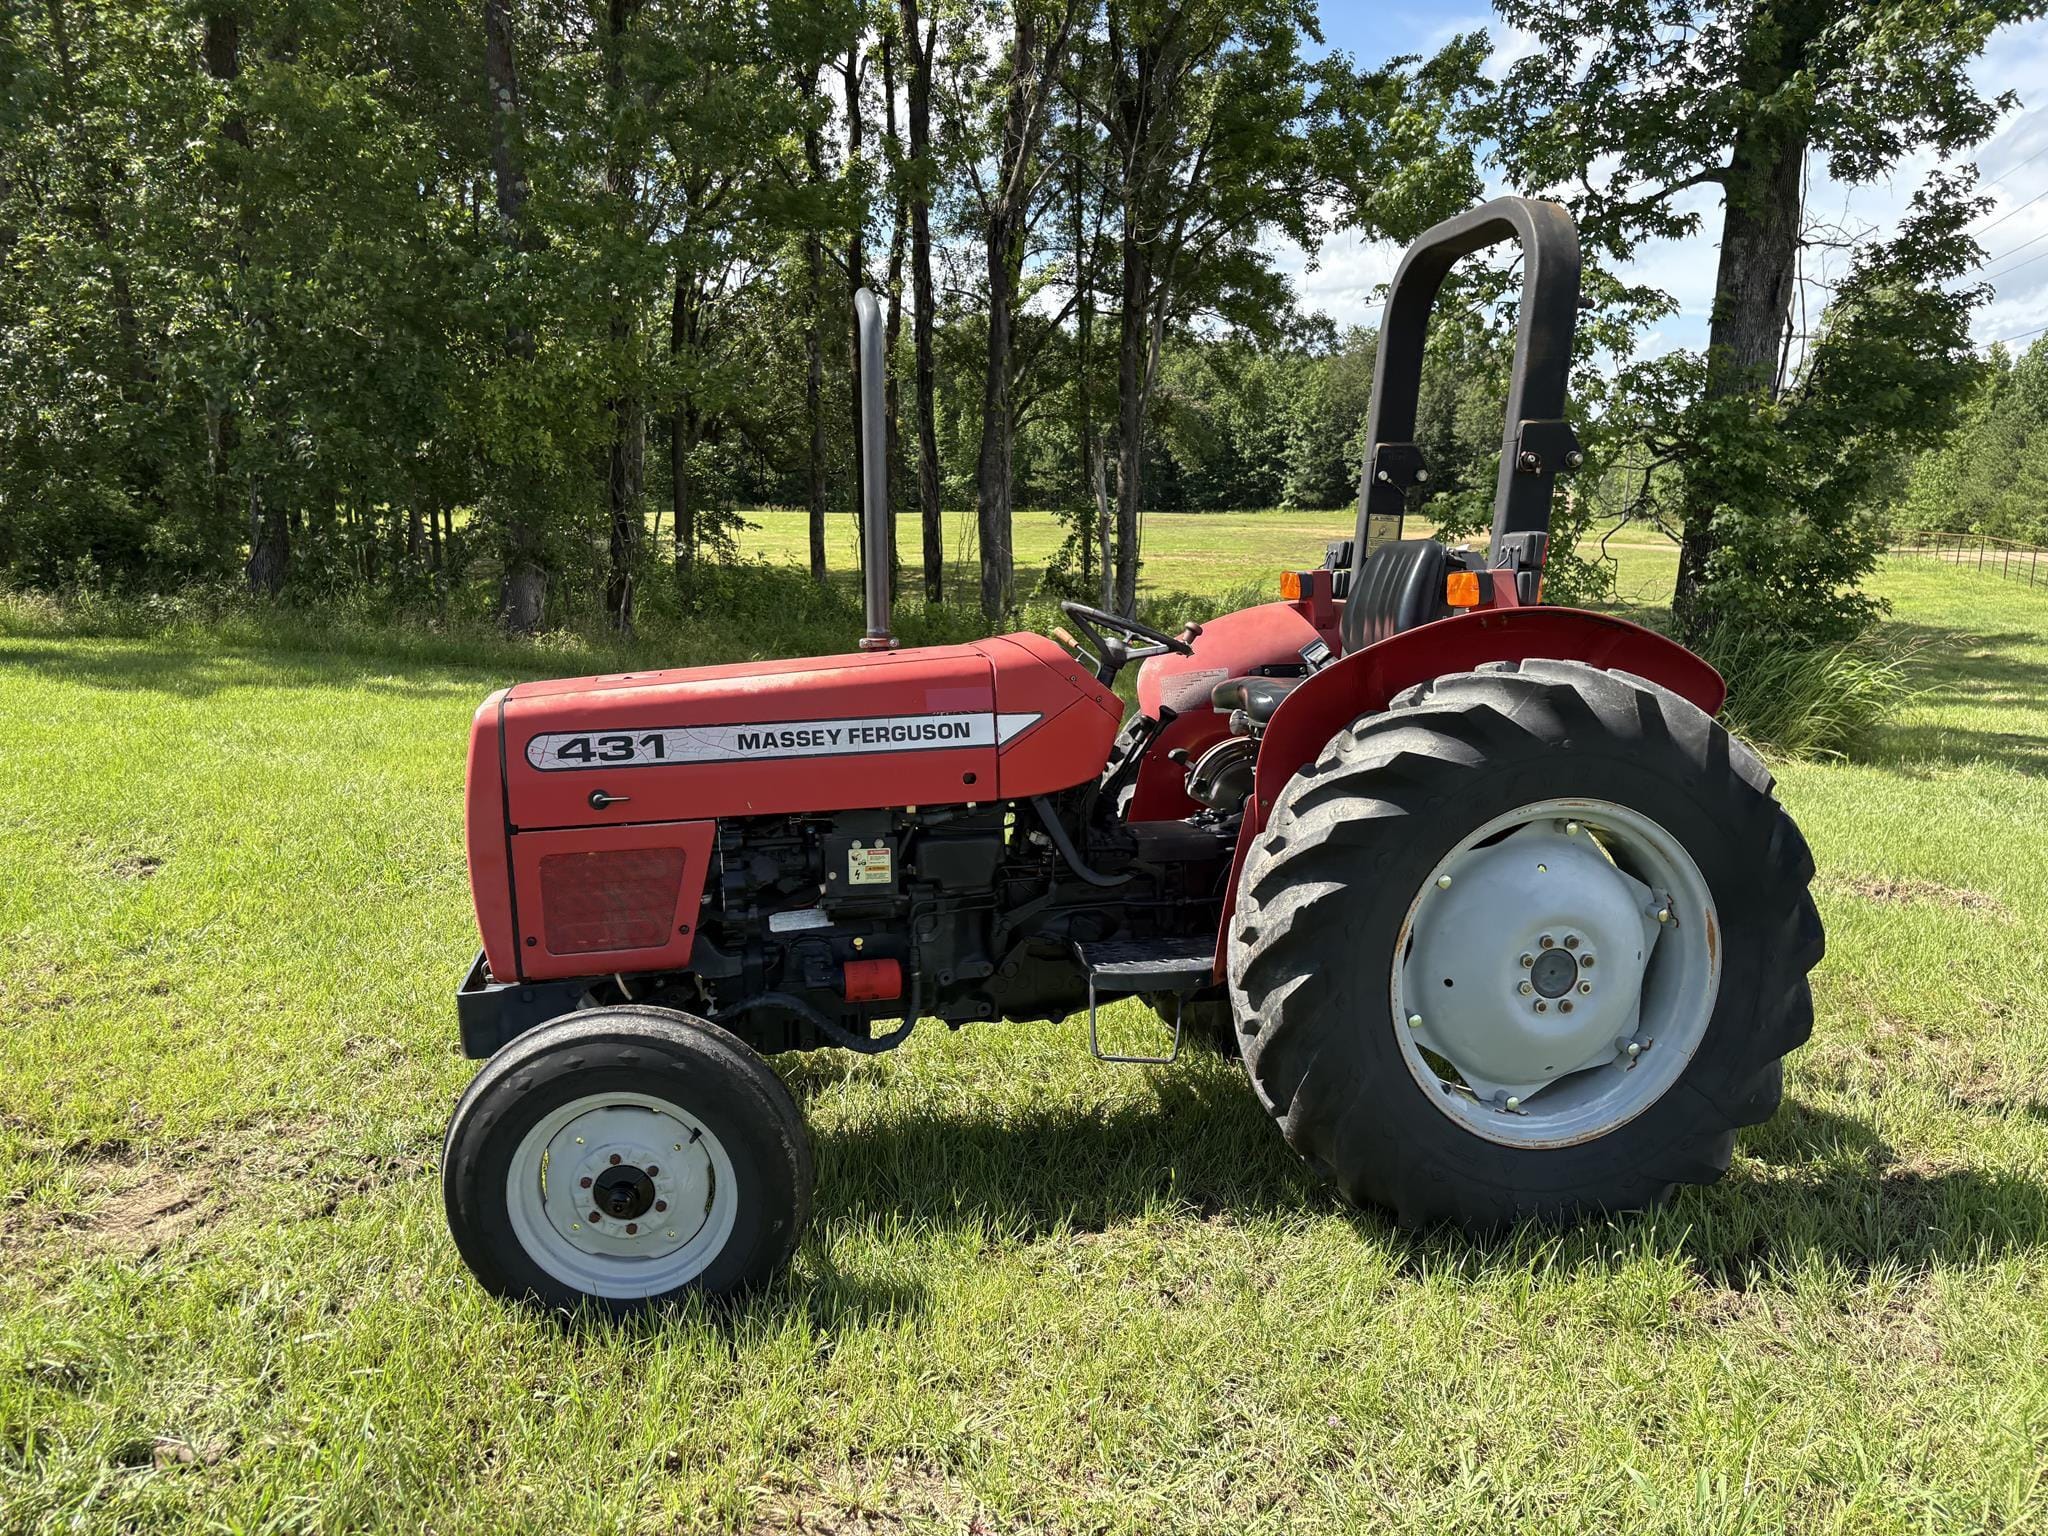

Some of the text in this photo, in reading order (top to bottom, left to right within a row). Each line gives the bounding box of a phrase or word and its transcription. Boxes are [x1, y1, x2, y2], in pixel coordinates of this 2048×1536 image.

[557, 722, 971, 763] 431 MASSEY FERGUSON
